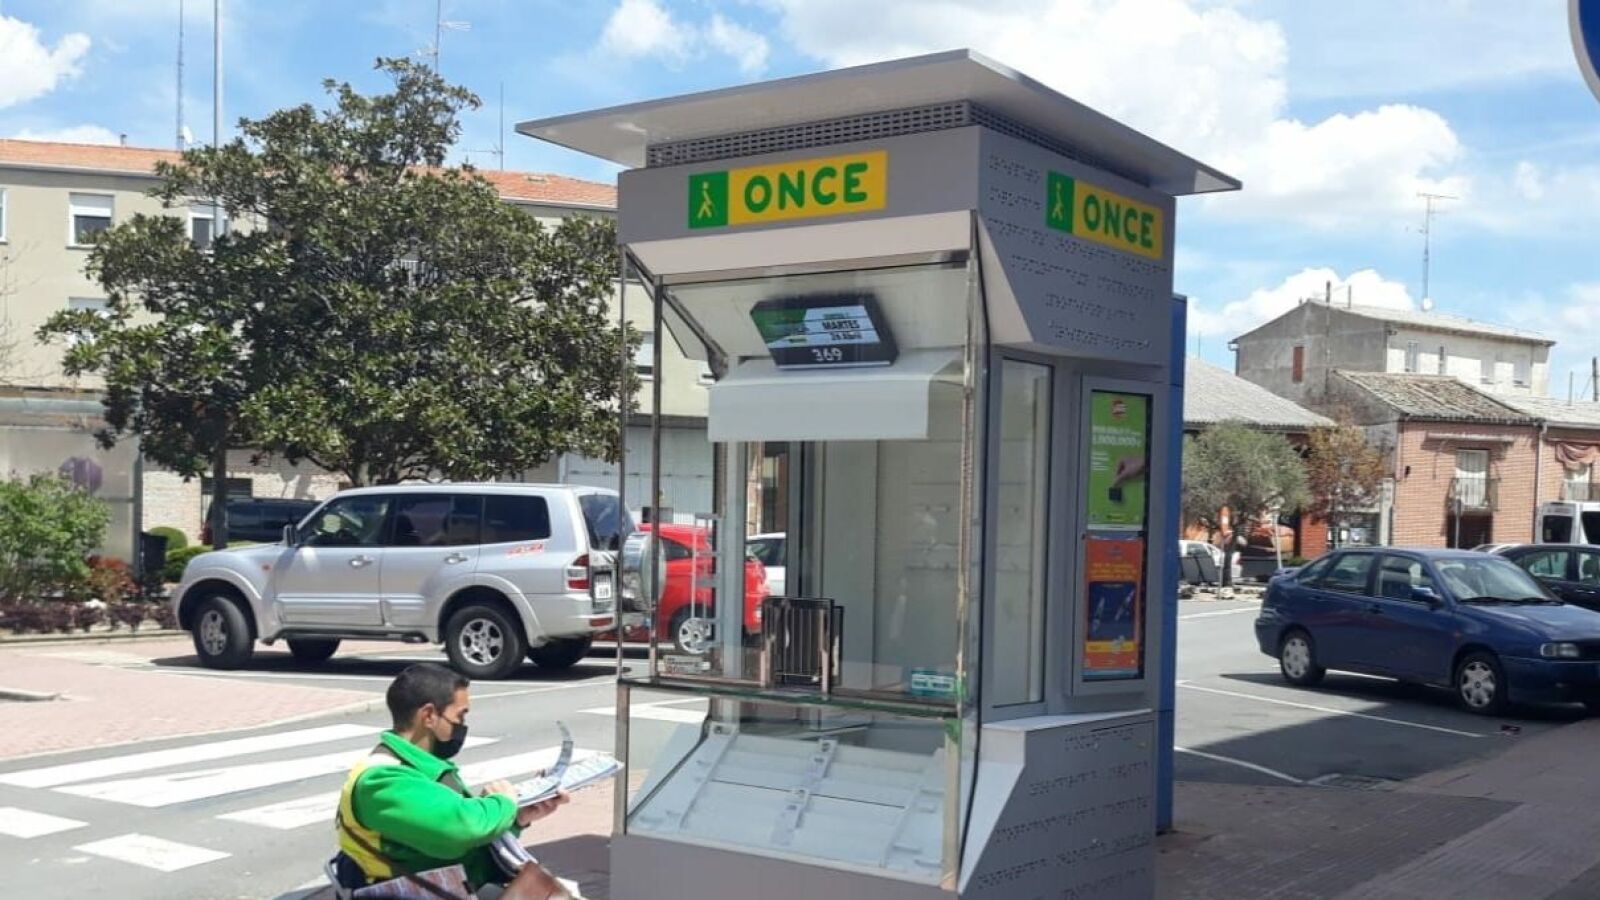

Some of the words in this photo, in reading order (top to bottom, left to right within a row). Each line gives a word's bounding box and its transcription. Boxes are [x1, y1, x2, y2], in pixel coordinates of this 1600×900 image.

[744, 161, 869, 213] ONCE
[1083, 194, 1154, 250] ONCE
[822, 319, 860, 330] MARTES
[812, 348, 843, 362] 369
